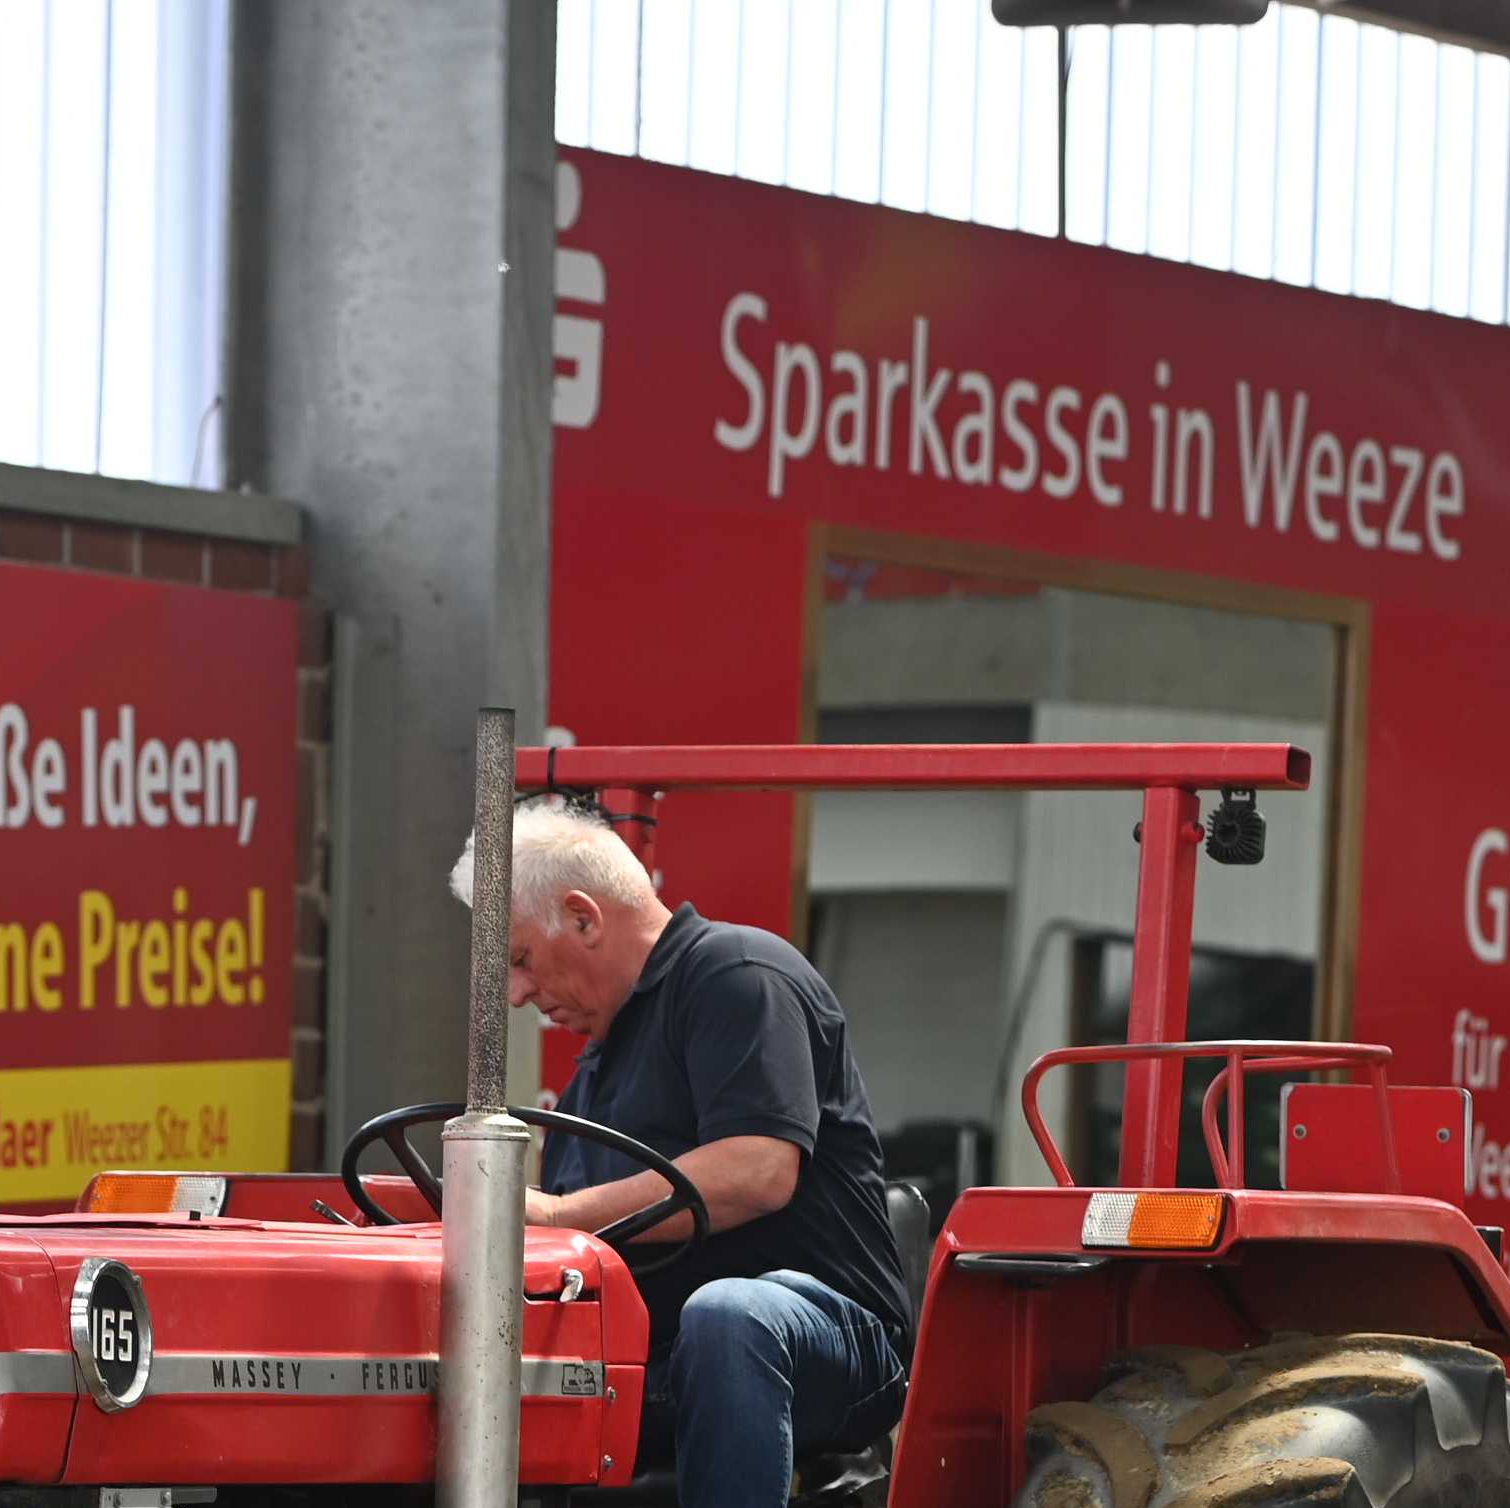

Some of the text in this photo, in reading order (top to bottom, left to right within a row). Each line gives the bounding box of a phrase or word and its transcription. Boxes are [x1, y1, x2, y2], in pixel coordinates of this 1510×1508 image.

[714, 290, 1464, 562] Sparkasse in Weeze
[81, 703, 257, 847] Ideen,
[78, 886, 265, 1010] Preise!
[1452, 1009, 1504, 1090] für
[64, 1108, 152, 1165] Weezer
[155, 1104, 192, 1162] Str.
[198, 1104, 229, 1158] 84
[92, 1307, 133, 1362] 165
[212, 1360, 301, 1389] MASSEY
